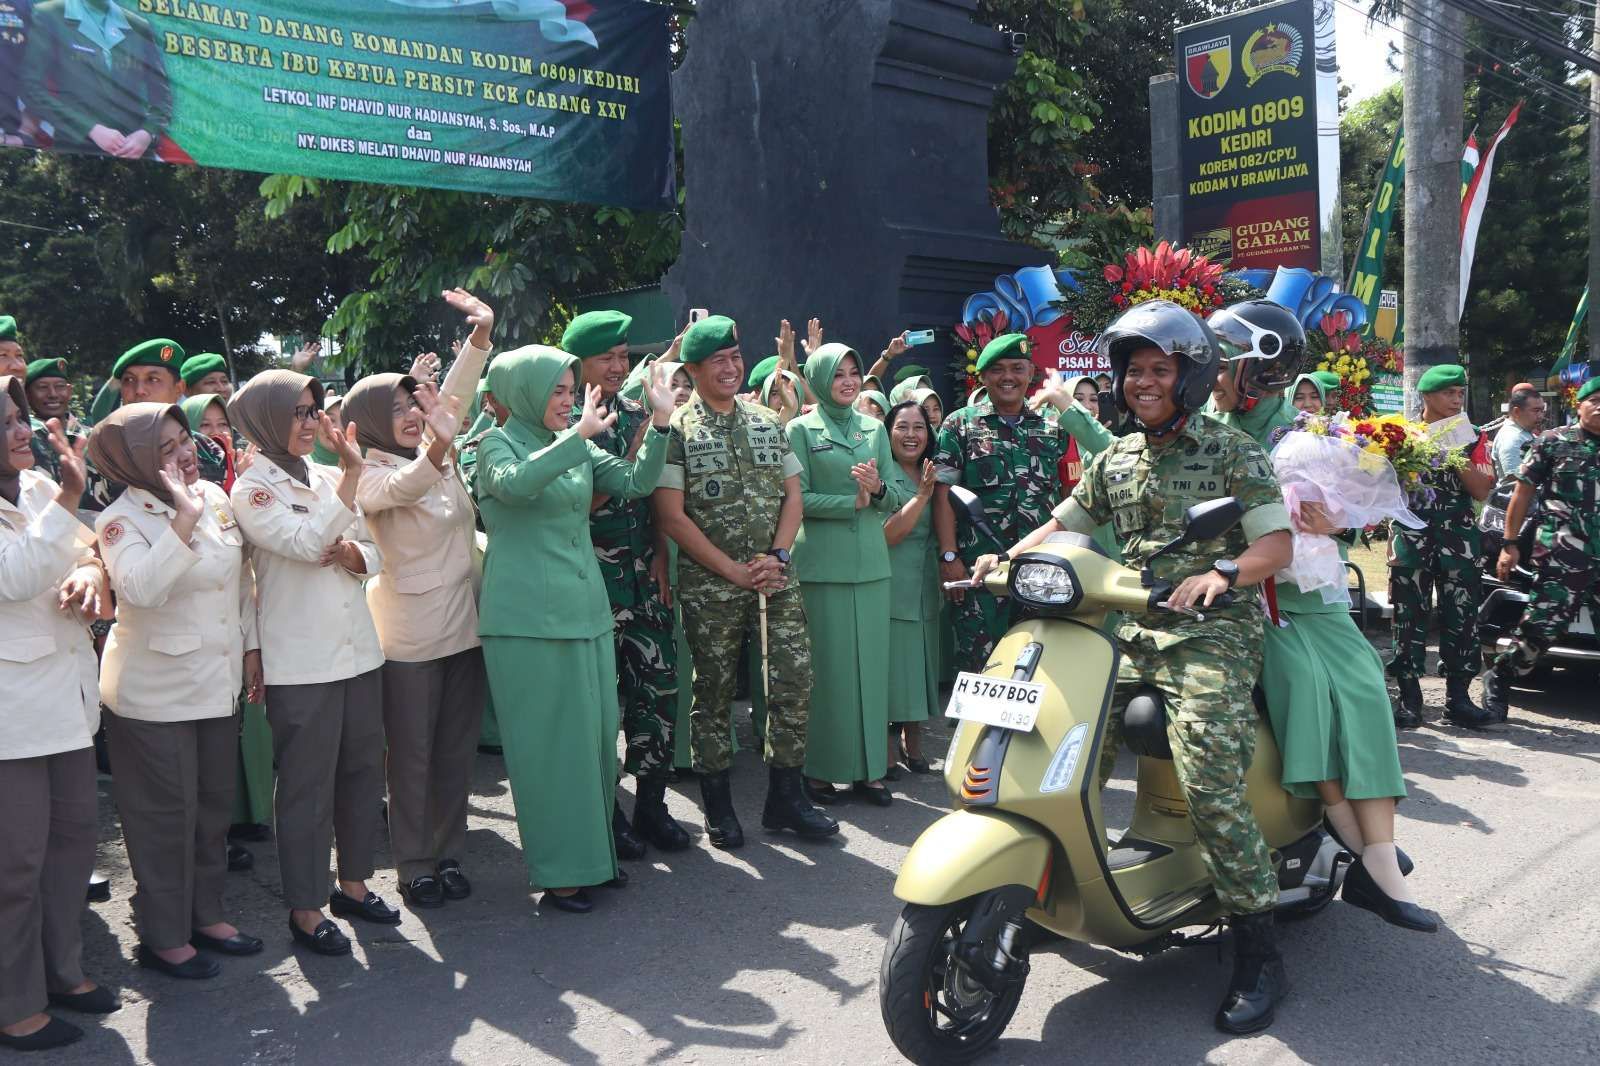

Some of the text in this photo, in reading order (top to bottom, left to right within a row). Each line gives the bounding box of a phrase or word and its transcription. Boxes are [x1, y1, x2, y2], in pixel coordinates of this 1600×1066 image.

[139, 0, 640, 94] SELAMAT DATANG KOMANDAN KODIM 0809/KEDIRI
[1188, 40, 1228, 54] BRAWIJAYA
[164, 31, 627, 121] BESERTA IBU KETUA PERSIT KCK CABANG XXV
[263, 87, 313, 107] LETKOL
[316, 94, 337, 109] INF
[340, 97, 384, 116] DHAVID
[387, 103, 412, 119] NUR
[414, 107, 487, 131] HADIANSYAH,
[489, 118, 500, 131] S.
[529, 123, 556, 139] M.A.P
[1188, 95, 1304, 139] KODIM 0809
[407, 126, 432, 141] dan
[1220, 128, 1272, 154] KEDIRI
[298, 134, 532, 173] NY. DIKES MELATI DHAVID NUR HADIANSYAH
[1199, 146, 1297, 176] KOREM 082/CPYJ
[1189, 163, 1309, 196] KODAM V BRAWIJAYA
[1236, 216, 1310, 237] GUDANG
[1236, 229, 1311, 250] GARAM
[1246, 248, 1274, 257] GUDANG
[1273, 245, 1299, 254] GARAM
[1058, 357, 1093, 369] PISAH
[688, 442, 713, 453] DHAVID
[752, 436, 778, 445] TNI AD
[1172, 481, 1217, 491] TNI AD
[958, 678, 1039, 704] H 5767 BDG
